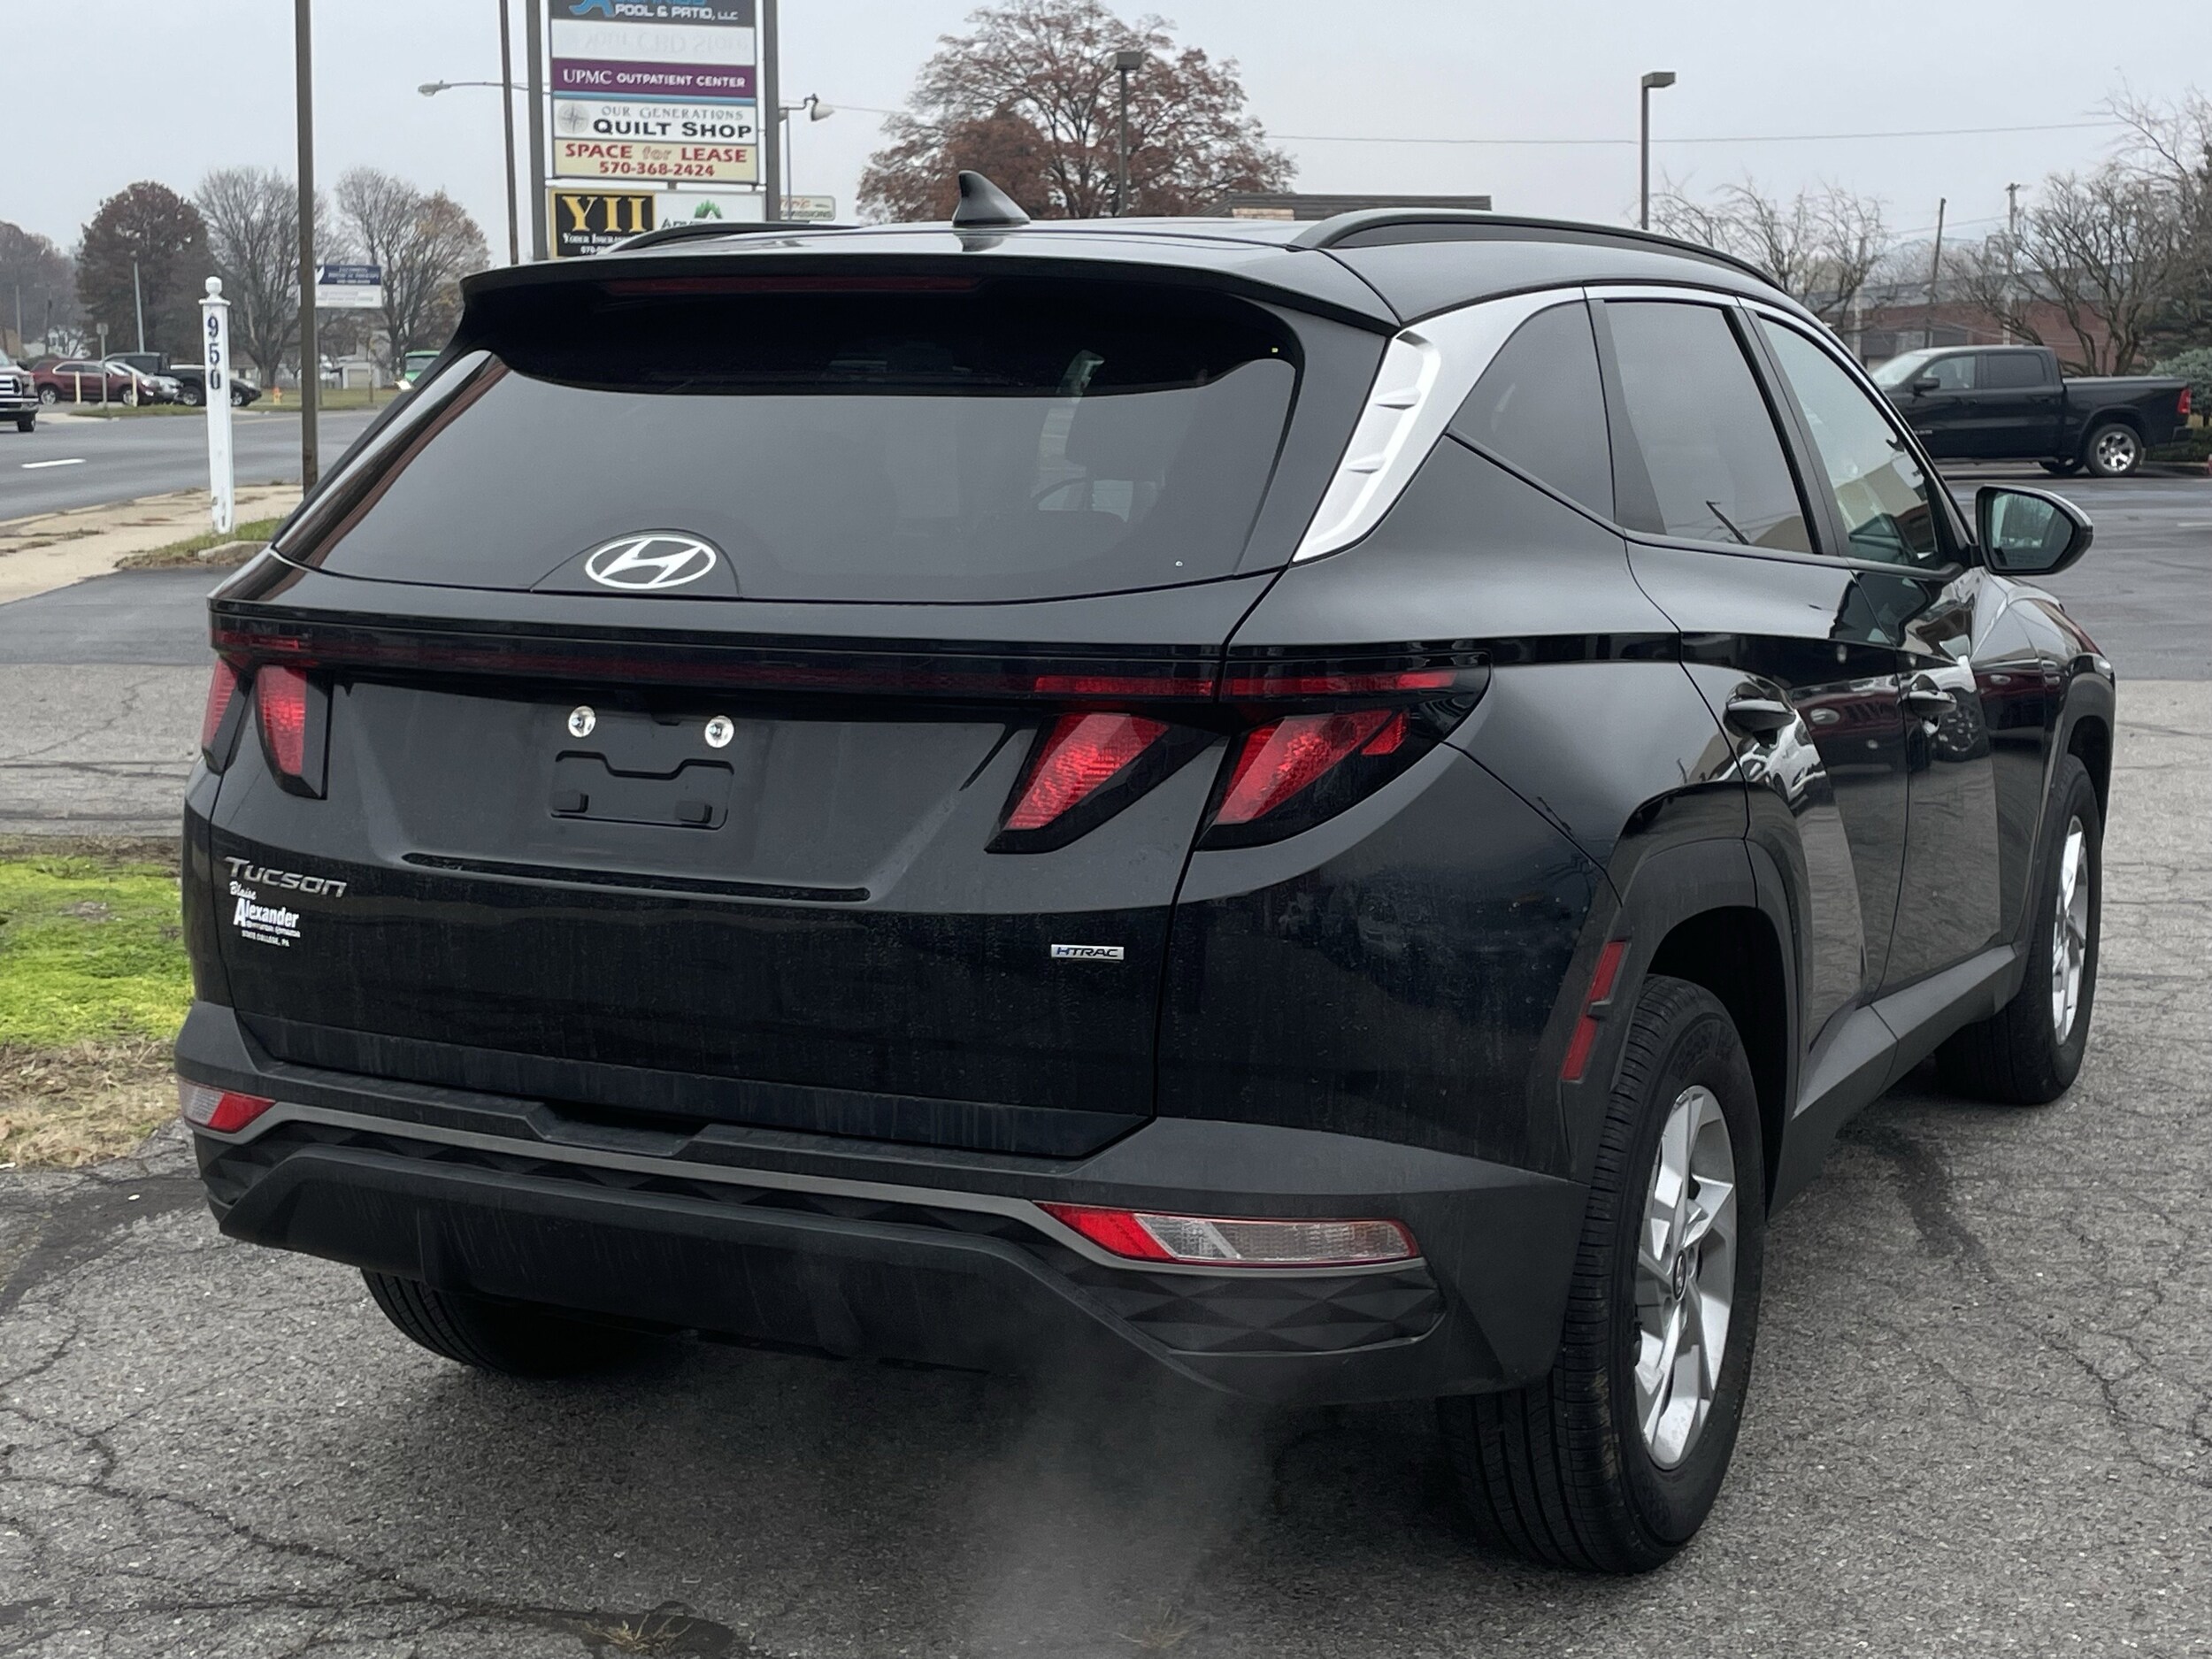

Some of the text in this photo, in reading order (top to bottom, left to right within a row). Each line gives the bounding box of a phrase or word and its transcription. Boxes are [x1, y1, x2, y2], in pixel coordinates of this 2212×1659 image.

[615, 4, 655, 18] POOL
[657, 5, 668, 18] &
[718, 11, 739, 21] LLC
[563, 68, 746, 88] UPMC OUTPATIENT CENTER
[602, 105, 744, 121] OUR GENERATIONS
[593, 119, 753, 139] QUILT SHOP
[565, 142, 748, 163] SPACE for LEASE
[599, 161, 716, 177] 570-368-2424
[562, 196, 648, 233] YII
[207, 312, 221, 389] 950
[233, 897, 300, 929] Alexander
[1056, 946, 1119, 957] HTRAC
